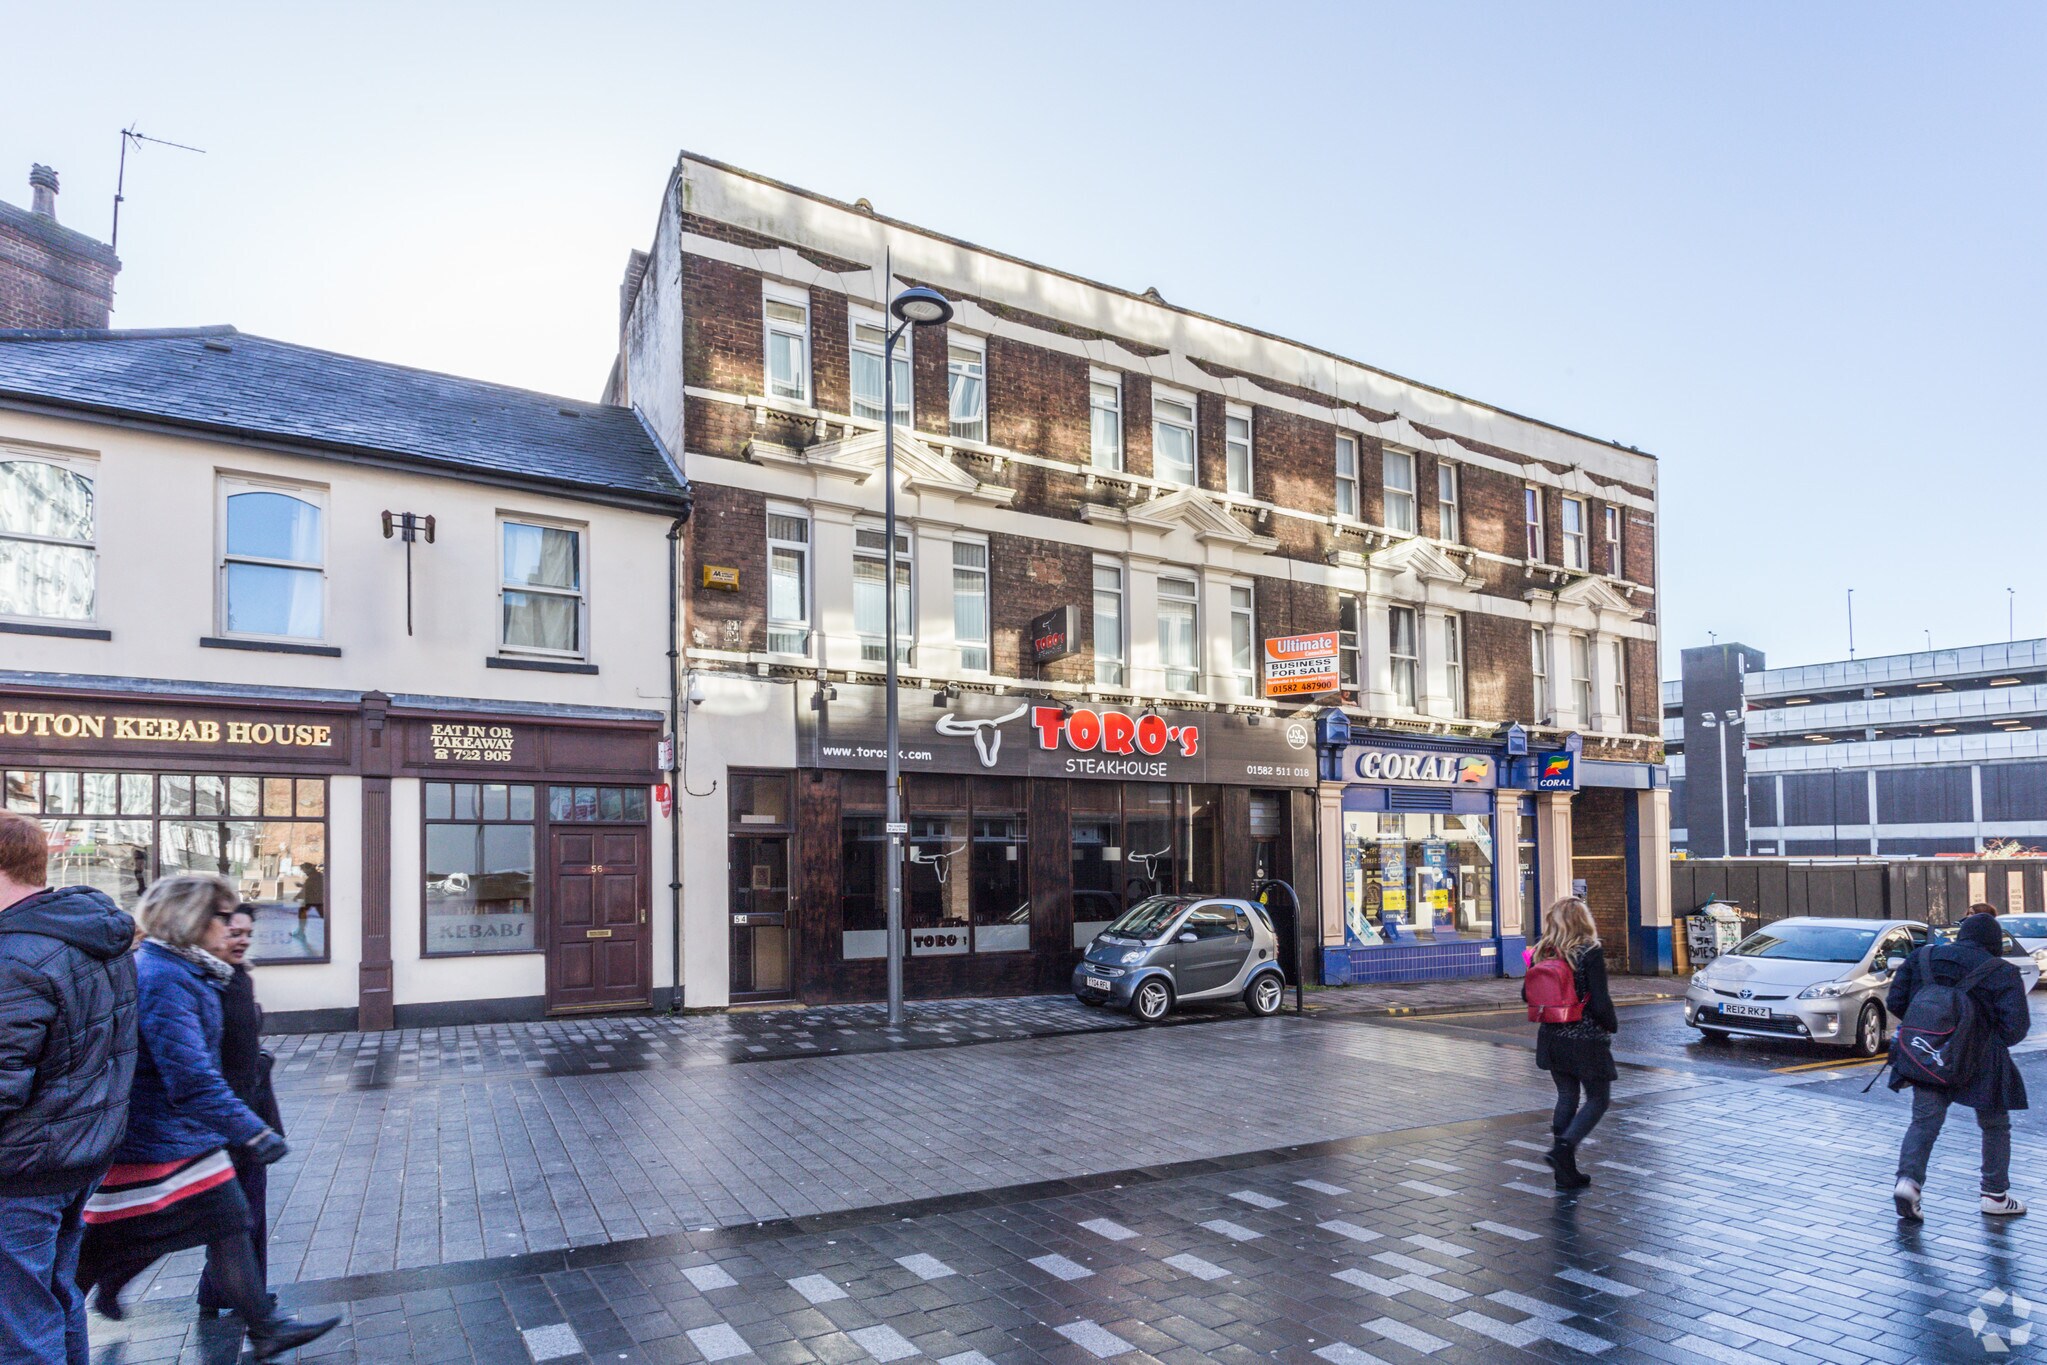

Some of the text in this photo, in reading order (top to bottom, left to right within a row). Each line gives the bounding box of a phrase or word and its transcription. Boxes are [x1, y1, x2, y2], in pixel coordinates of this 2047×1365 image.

[1277, 636, 1332, 654] Ultimate
[1272, 658, 1331, 670] BUSINESS
[1300, 666, 1331, 674] SALE
[1273, 682, 1332, 693] 01582 487900
[113, 716, 220, 743] KEBAB
[227, 722, 332, 746] HOUSE
[432, 724, 513, 738] EAT IN OR
[430, 736, 514, 750] TAKEAWAY
[454, 749, 512, 761] 722 905
[1066, 758, 1168, 776] STEAKHOUSE
[1247, 765, 1309, 777] 01582 511 018
[1362, 752, 1457, 782] CORAL
[591, 864, 603, 873] 56
[440, 922, 525, 940] KEBABS
[1726, 1005, 1766, 1016] RE12 RKZ
